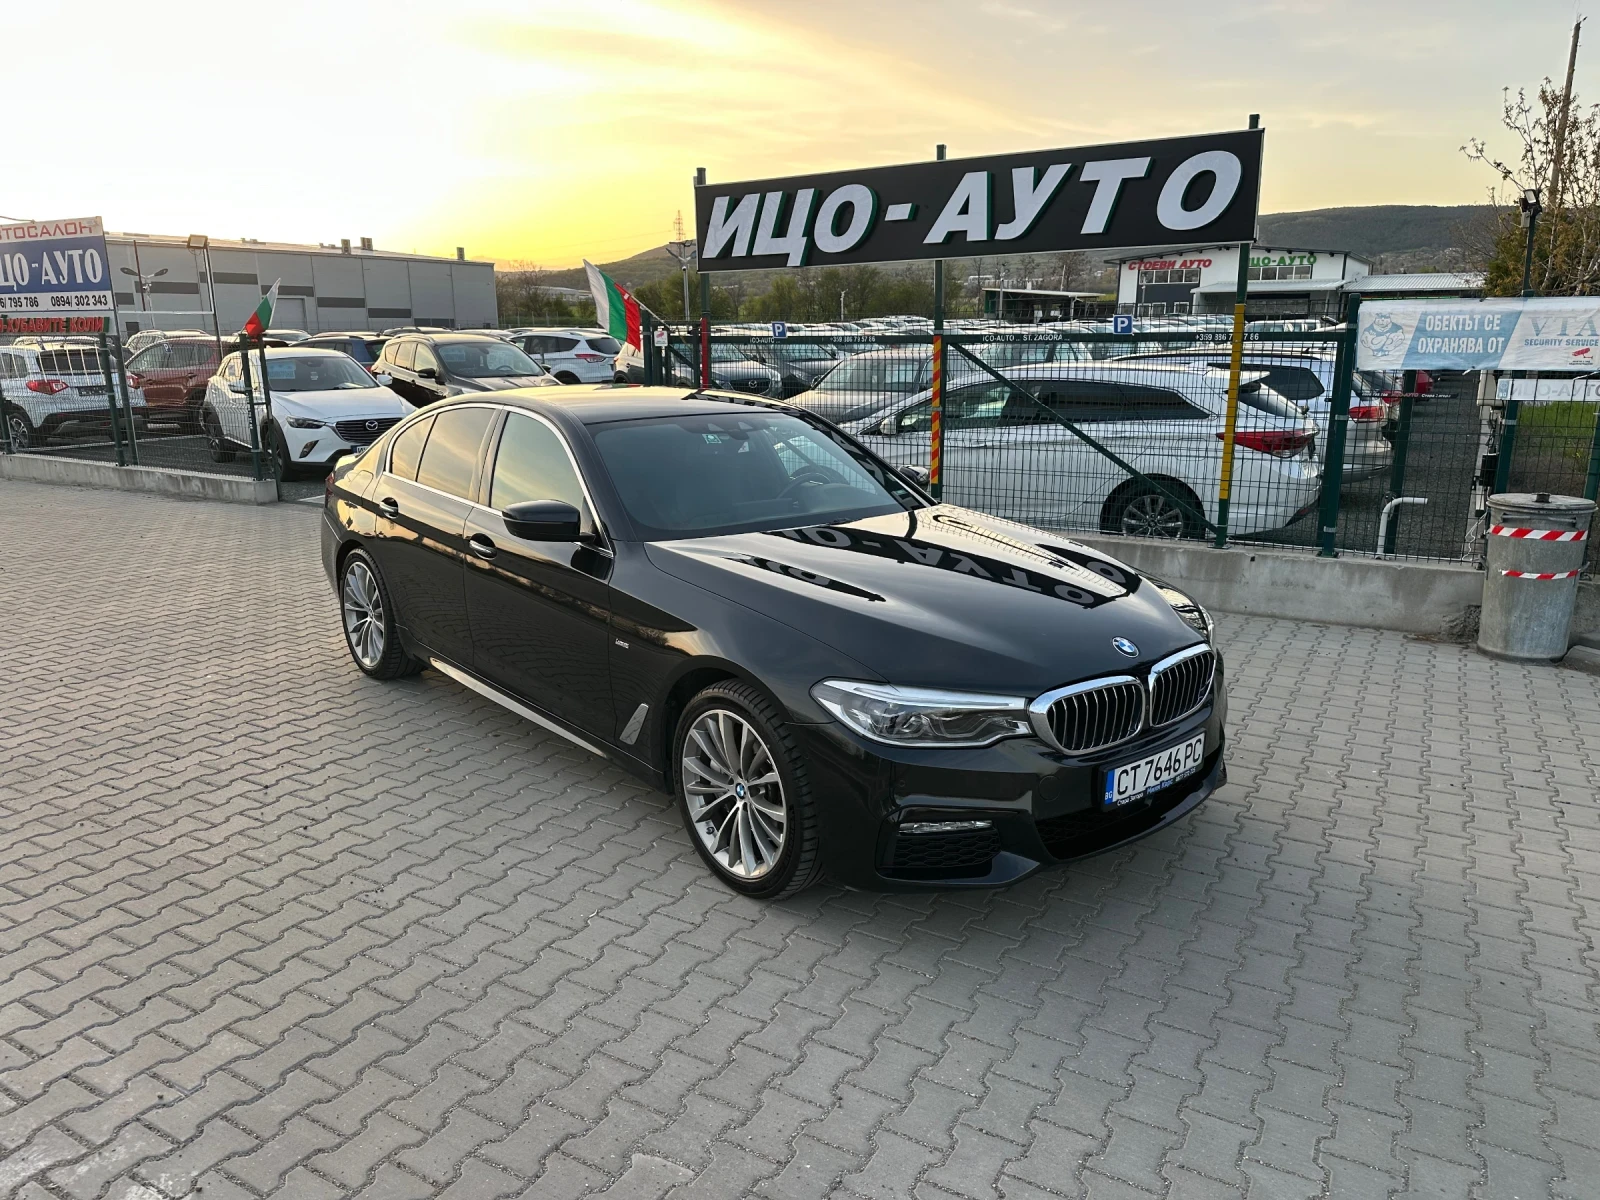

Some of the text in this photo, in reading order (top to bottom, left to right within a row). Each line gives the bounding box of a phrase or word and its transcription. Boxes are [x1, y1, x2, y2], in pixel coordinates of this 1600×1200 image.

[0, 221, 92, 240] ТОСАЛОН
[1128, 259, 1212, 270] СТОЕВИ АУТО
[1249, 255, 1317, 267] ЦО-АУТО
[8, 297, 22, 308] 795
[24, 296, 39, 308] 786
[74, 295, 90, 306] 302
[92, 294, 108, 306] 343
[0, 316, 104, 333] -ХУБАВИТЕ КОЛИ
[1117, 317, 1129, 332] P
[1425, 314, 1501, 331] ОБЕКТЪТ СЕ
[1528, 315, 1600, 337] VTA
[1417, 337, 1505, 353] ОХРАНЯВА ОТ
[1143, 747, 1182, 787] 7646
[1104, 790, 1113, 800] BG
